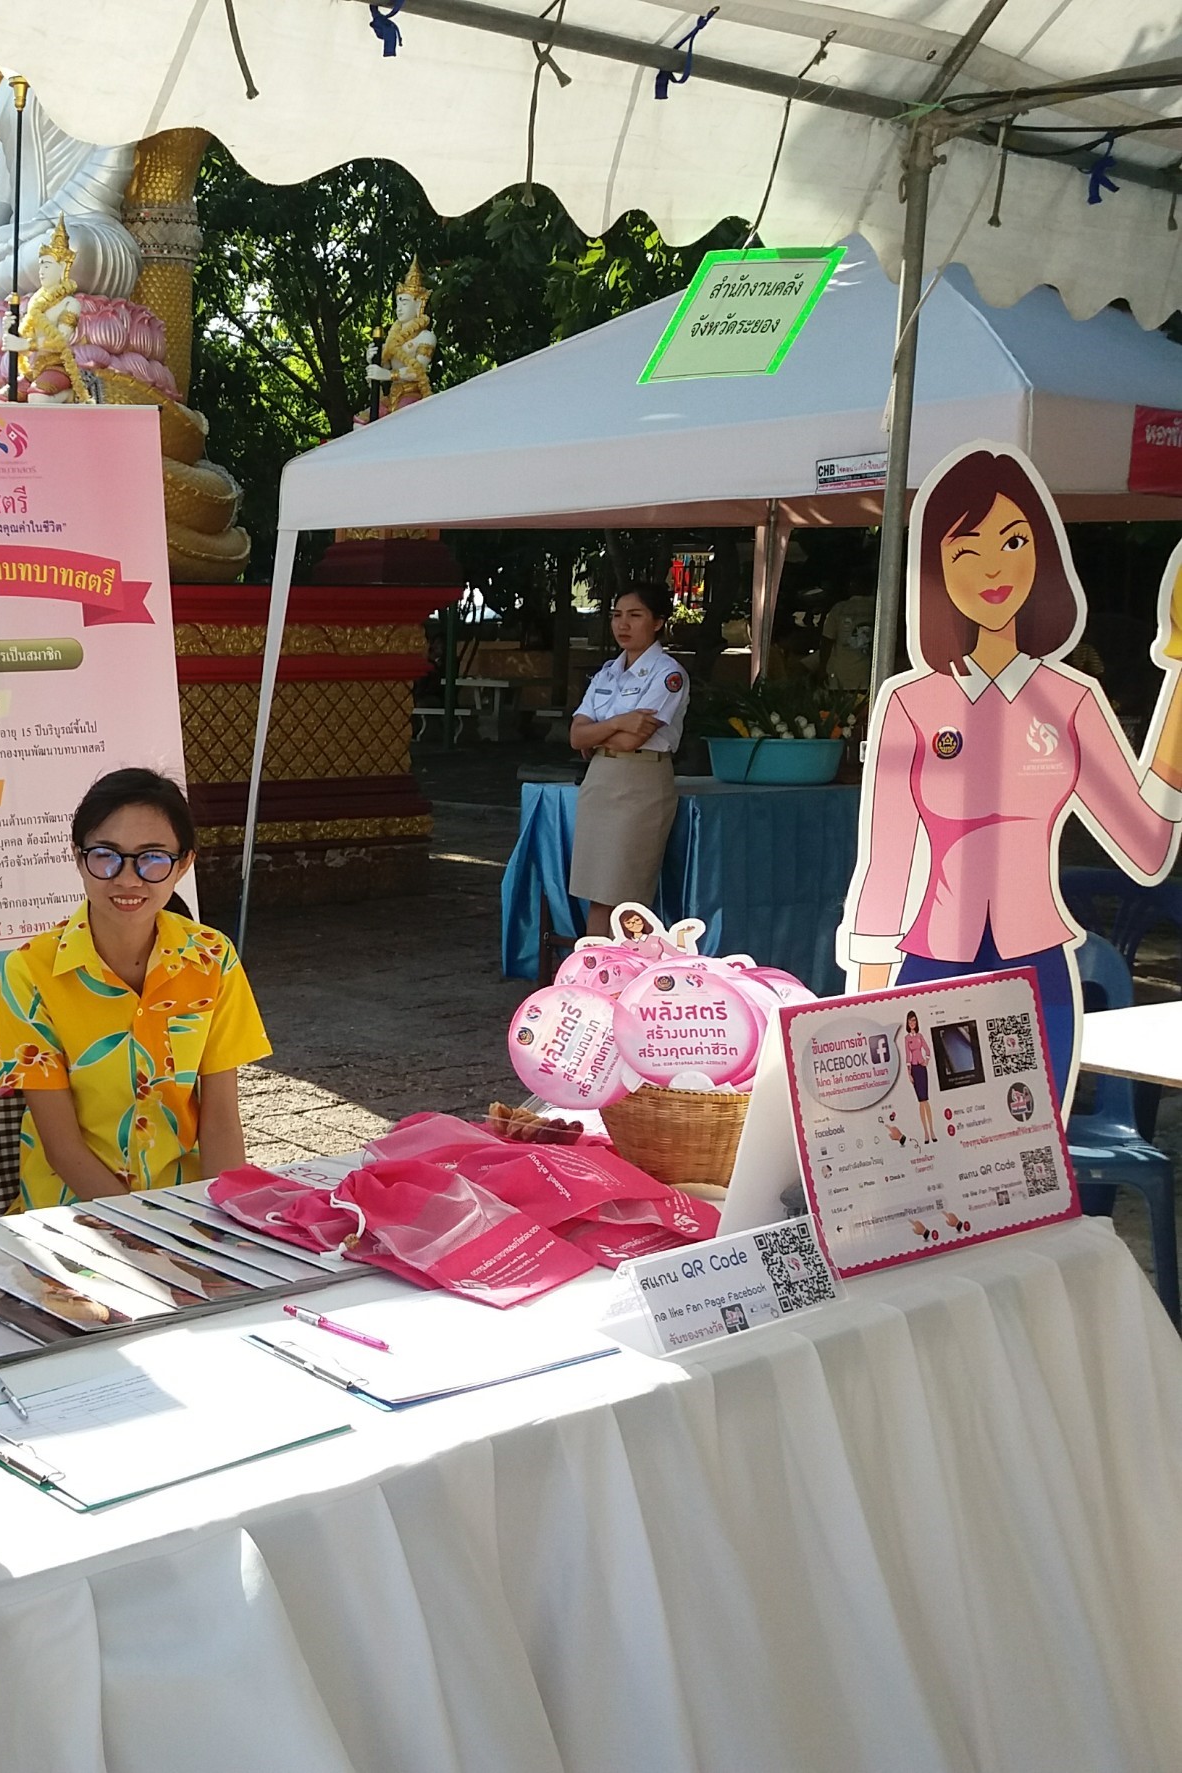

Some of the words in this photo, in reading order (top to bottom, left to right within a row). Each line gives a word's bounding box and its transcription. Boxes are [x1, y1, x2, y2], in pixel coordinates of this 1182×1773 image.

[709, 273, 804, 299] สำนักงานคลัง
[690, 312, 781, 338] จังหวัดระยอง
[818, 464, 835, 477] CHB
[21, 726, 32, 737] 15
[7, 923, 14, 936] 3
[639, 1000, 728, 1021] พลังสตรี
[538, 1001, 582, 1076] พลังสตรี
[646, 1024, 726, 1040] สร้างบทบาท
[811, 1032, 868, 1055] ขั้นตอนการเข้า
[561, 1020, 600, 1082] สร้างบทบาท
[638, 1041, 738, 1059] สร้างคุณค่าชีวิต
[576, 1027, 615, 1097] สร้างคุณค่าชีวิ
[813, 1052, 869, 1075] FACEBOOK
[814, 1124, 846, 1139] facebook
[979, 1164, 992, 1176] QR
[994, 1159, 1016, 1173] Code
[639, 1269, 679, 1292] สแกน
[681, 1258, 706, 1280] QR
[709, 1247, 749, 1273] Code
[654, 1312, 668, 1323] กด
[668, 1306, 685, 1319] like
[685, 1303, 704, 1314] Fan
[704, 1296, 726, 1309] Page
[727, 1283, 768, 1302] Facebook
[669, 1319, 725, 1346] รับของรางวัล
